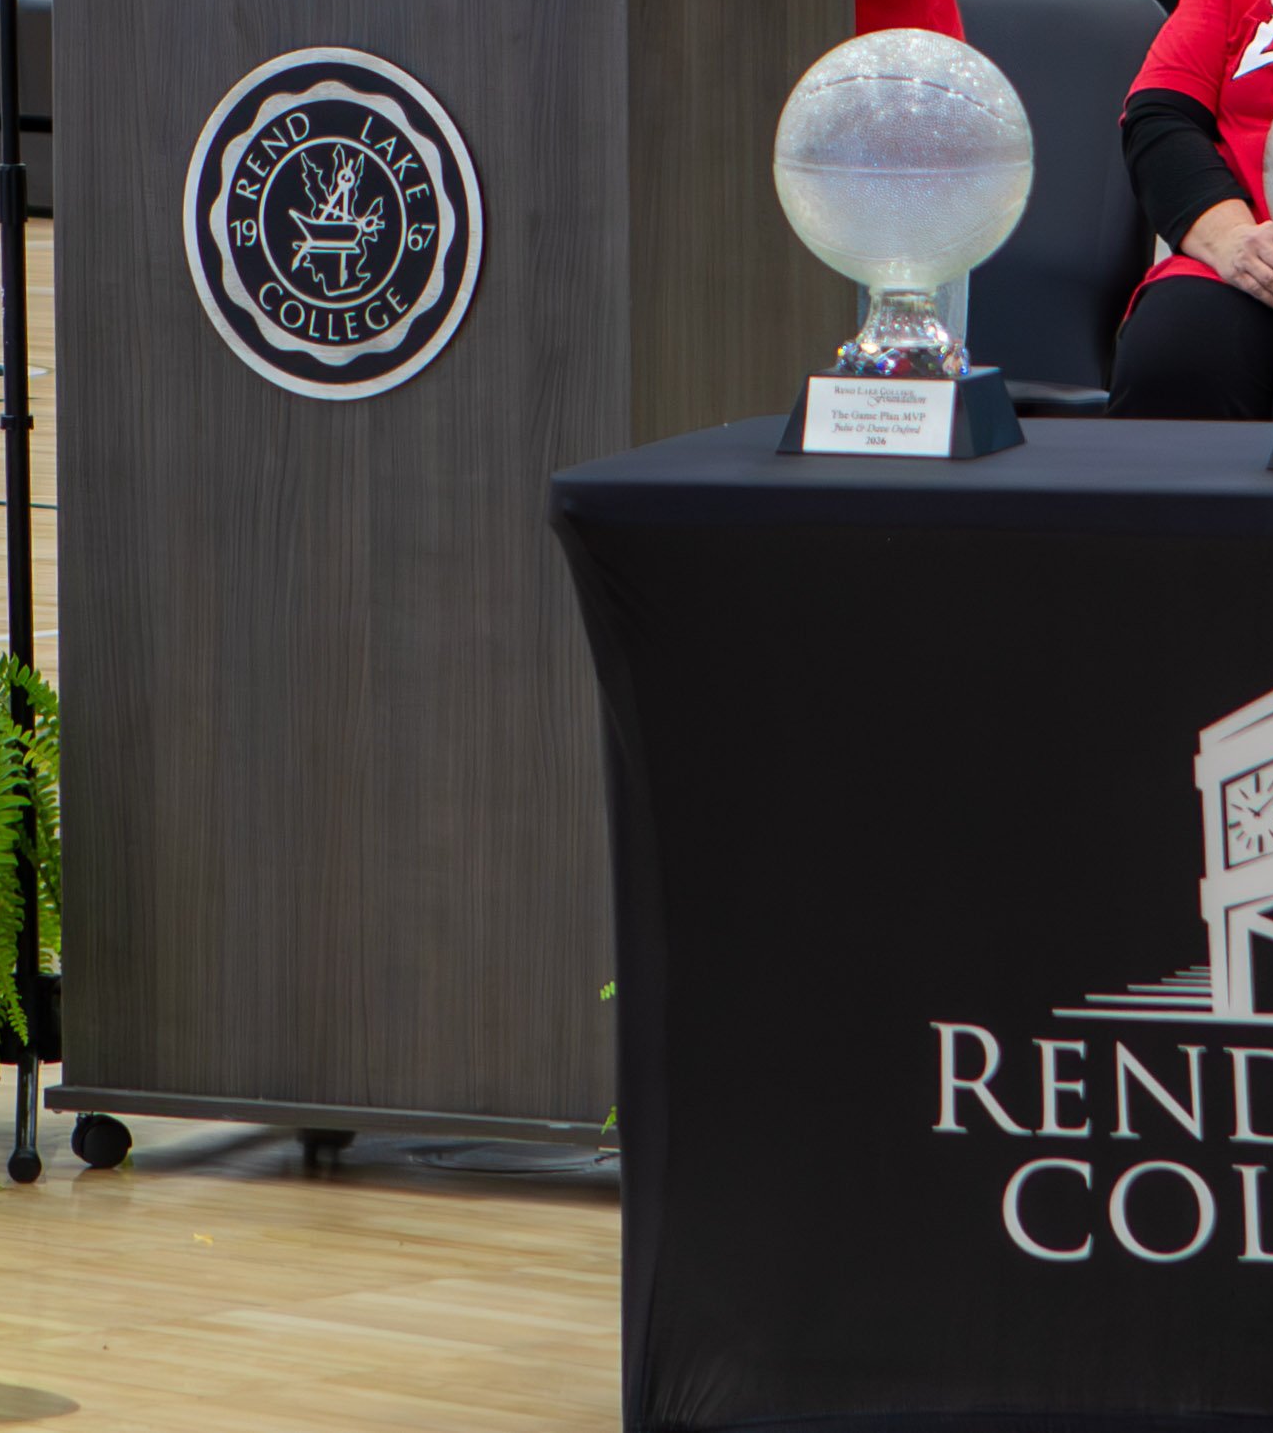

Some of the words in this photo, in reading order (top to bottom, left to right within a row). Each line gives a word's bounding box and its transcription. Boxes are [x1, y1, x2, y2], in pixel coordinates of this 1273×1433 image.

[235, 112, 310, 201] REND
[360, 116, 430, 204] LAKE
[230, 219, 259, 247] 19
[406, 223, 437, 252] 67
[258, 282, 409, 341] COLLEGE
[831, 410, 848, 420] The
[851, 410, 876, 421] Game
[880, 411, 899, 421] Plan
[902, 412, 926, 422] MVP
